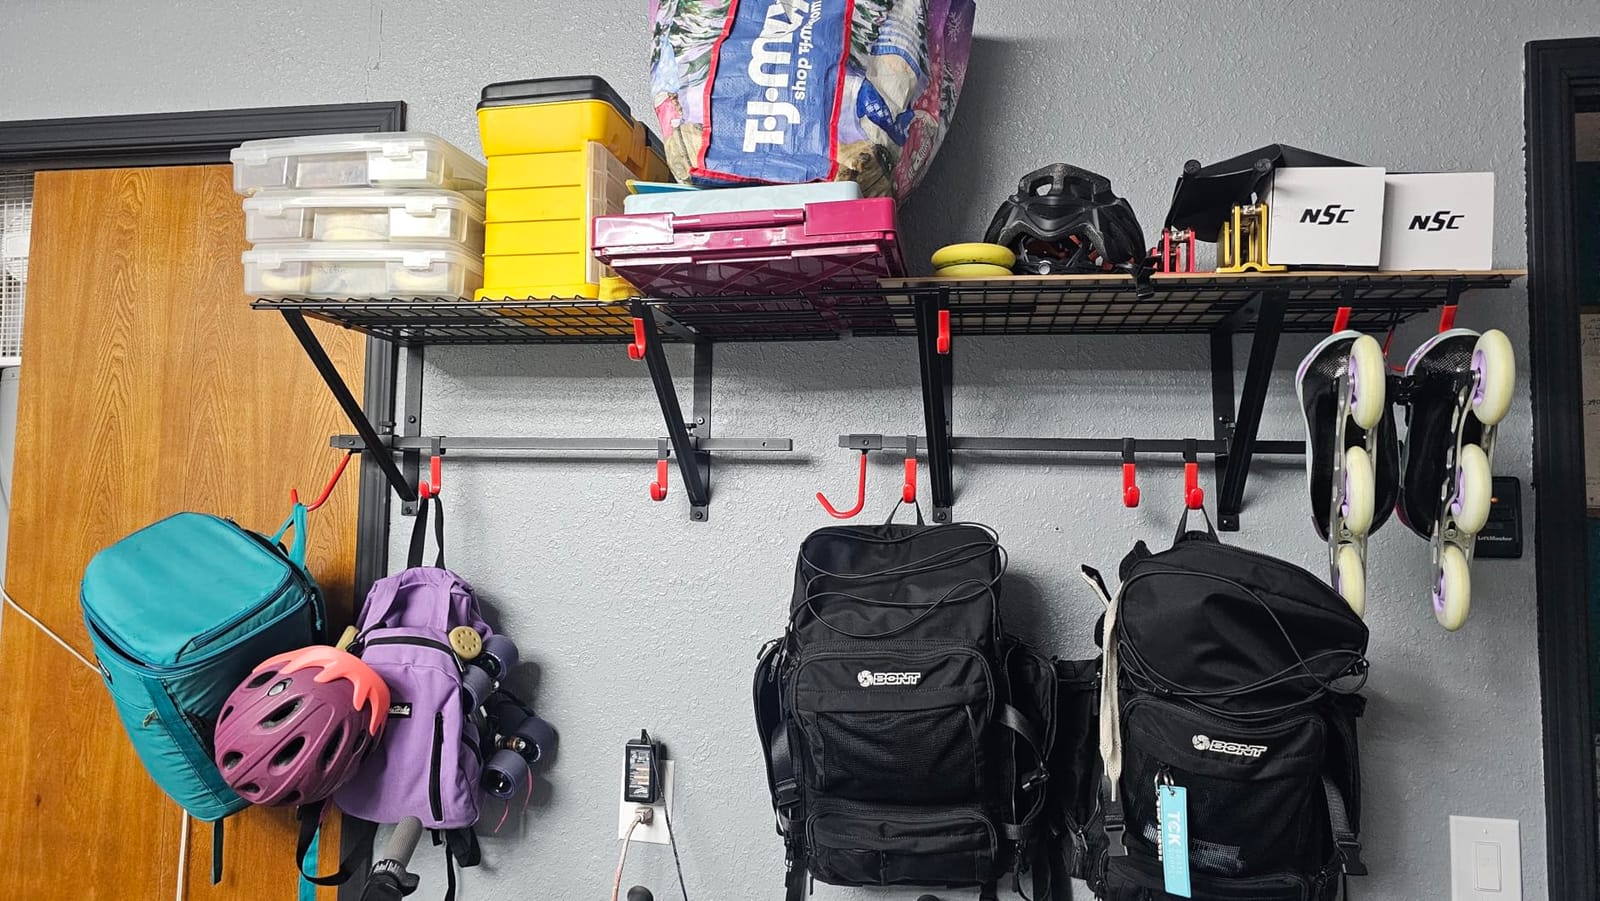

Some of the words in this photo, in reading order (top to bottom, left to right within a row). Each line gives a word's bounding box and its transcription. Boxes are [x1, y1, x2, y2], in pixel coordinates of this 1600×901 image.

[792, 58, 813, 100] shop
[1300, 204, 1355, 226] NSC
[1408, 211, 1465, 232] NSC
[873, 672, 921, 686] BONT
[1209, 740, 1268, 757] BONT
